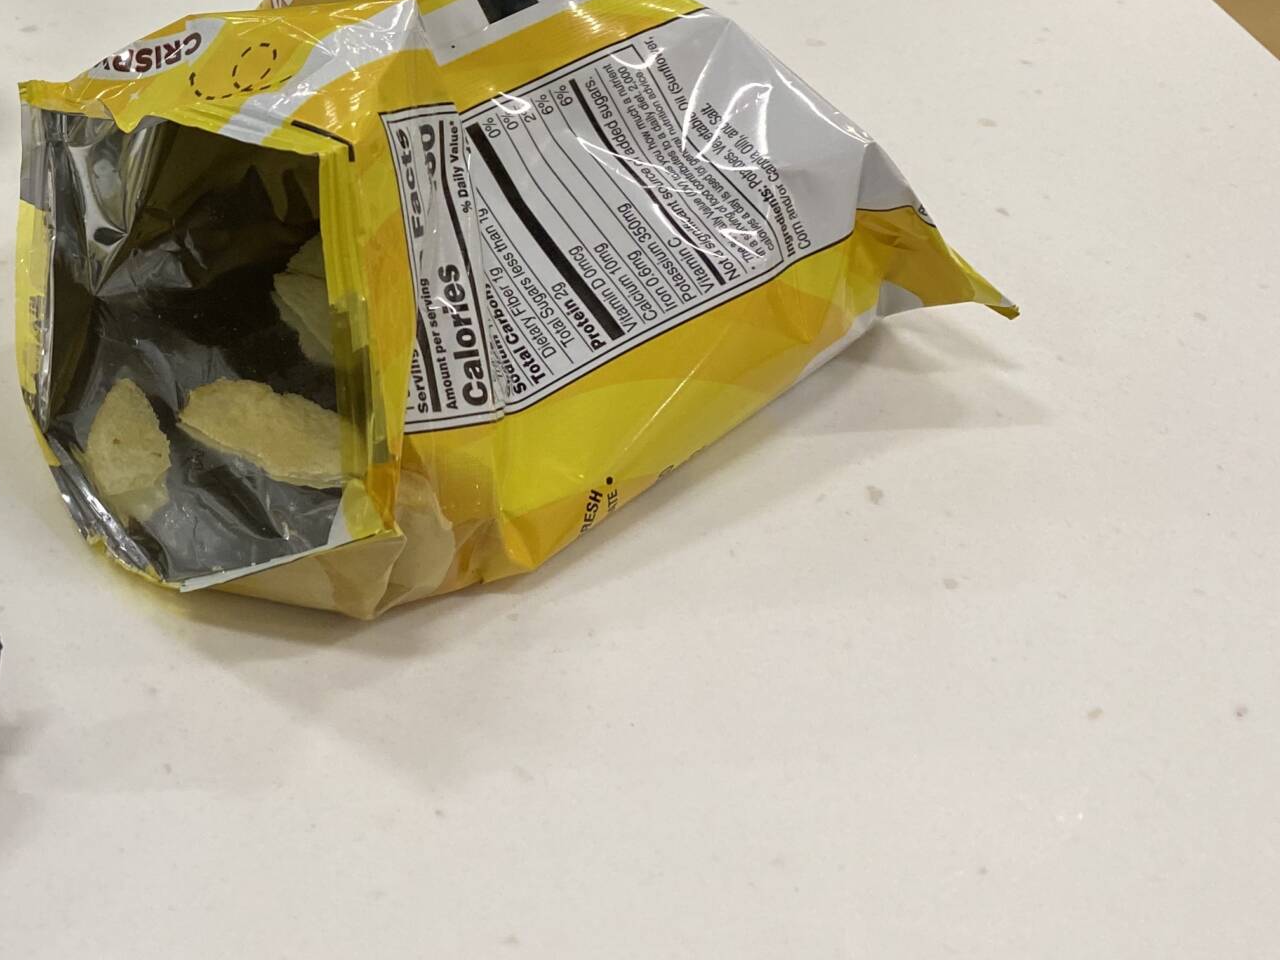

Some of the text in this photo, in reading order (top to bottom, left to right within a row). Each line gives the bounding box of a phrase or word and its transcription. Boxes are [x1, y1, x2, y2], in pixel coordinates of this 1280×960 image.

[602, 63, 628, 98] nutrient
[645, 36, 684, 95] (Sunfloer,
[585, 76, 613, 120] sugars.
[700, 102, 722, 125] Salt.
[628, 104, 646, 131] much
[645, 109, 662, 132] daily
[652, 100, 676, 136] nutrition
[605, 120, 636, 156] added
[641, 131, 656, 151] how
[662, 140, 672, 151] to
[654, 148, 667, 165] you
[668, 150, 705, 190] contributes
[396, 128, 424, 238] Facts
[452, 166, 469, 198] Daily
[536, 93, 697, 302] Potassium 350mg 6%
[554, 84, 715, 294] Vitamin C 6%
[641, 167, 673, 200] source
[704, 173, 724, 193] used
[721, 192, 731, 201] is
[694, 197, 715, 219] Value
[728, 198, 745, 214] day
[776, 183, 799, 221] and/or
[482, 117, 638, 333] Vitamin D 0mcg 0%
[758, 185, 797, 258] Ingredients:
[793, 220, 812, 250] Corn
[489, 266, 504, 283] 1g
[593, 242, 623, 276] 10mg
[718, 257, 742, 281] Not
[485, 224, 575, 349] Total Sugars less than
[618, 273, 658, 321] Calcium
[627, 250, 678, 314] Iron 0.6mg
[499, 285, 523, 318] Fiber
[551, 281, 608, 351] Protein 2g
[420, 278, 458, 410] Amount per serving
[438, 264, 488, 406] Calories
[521, 316, 557, 359] Dietary
[513, 346, 546, 385] Total
